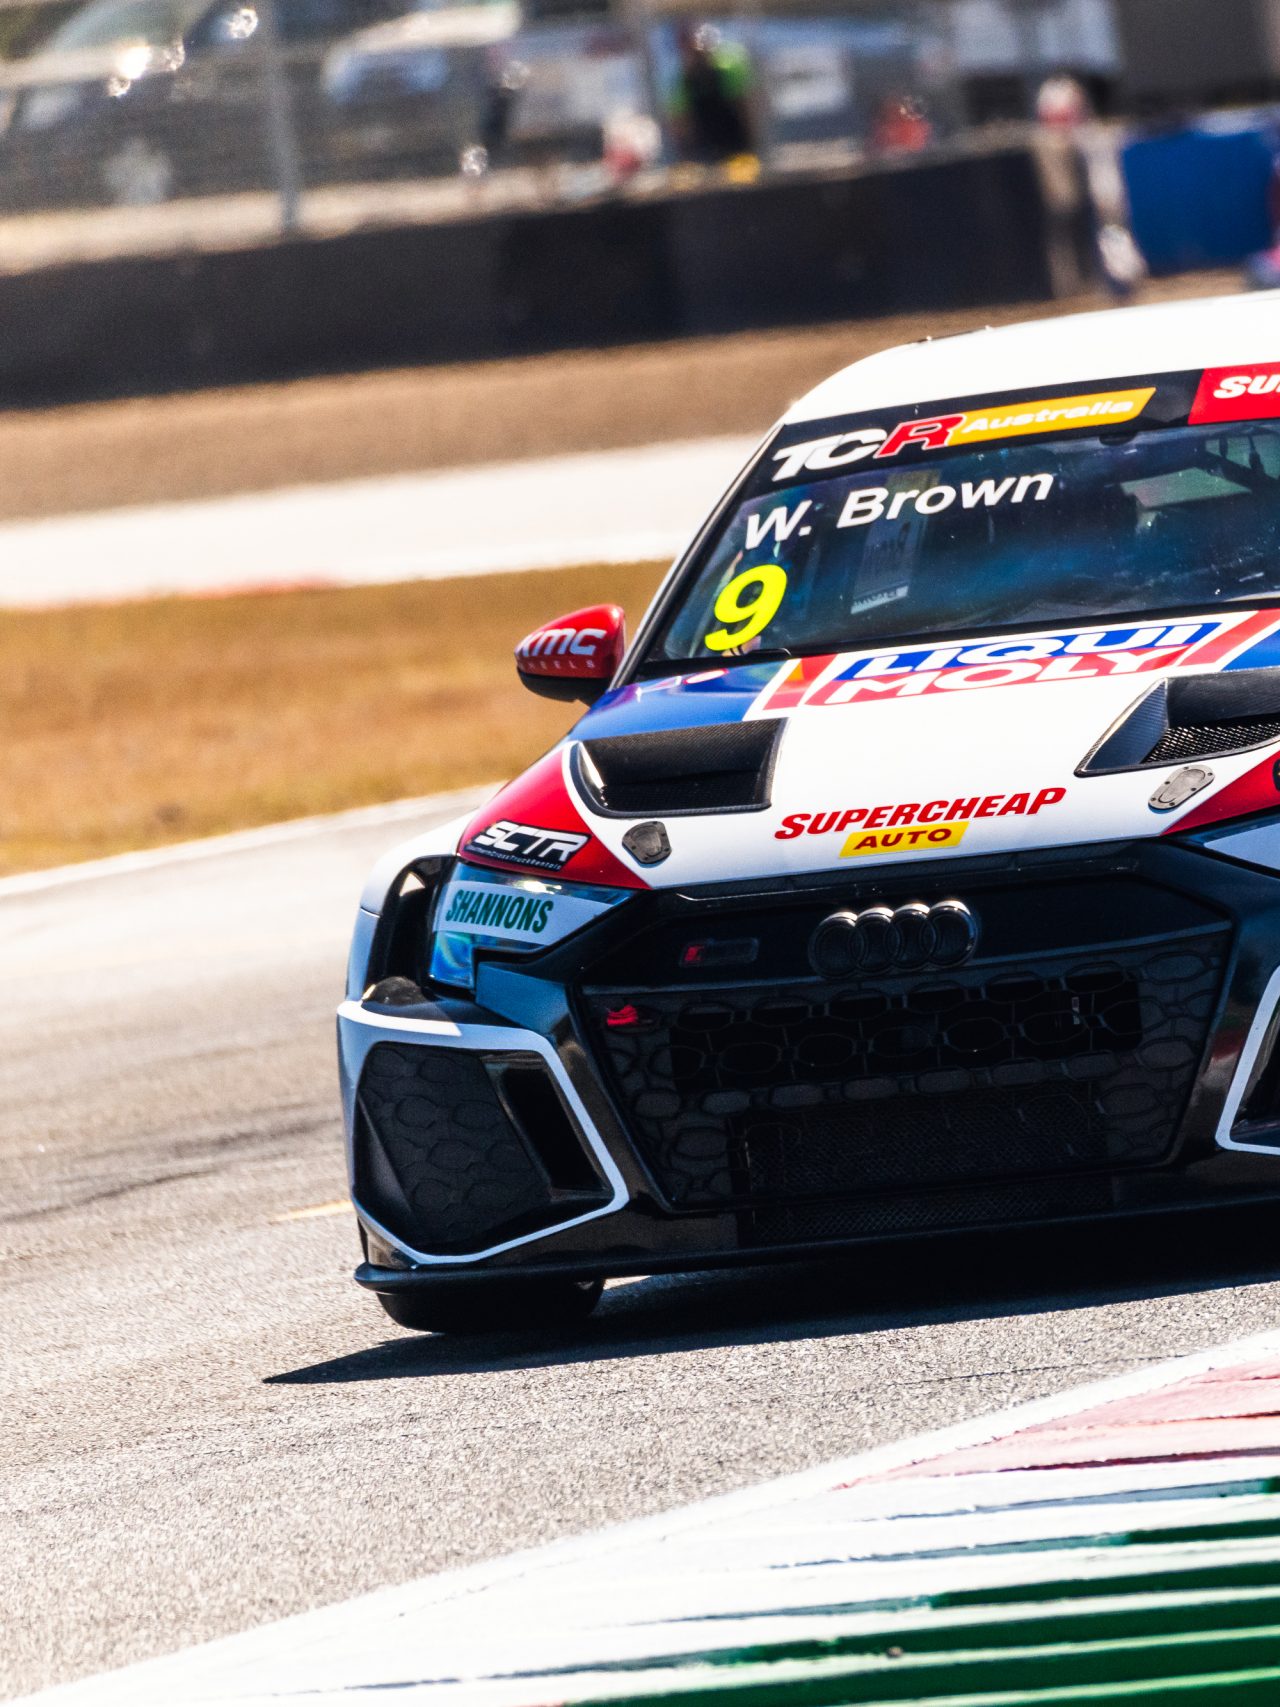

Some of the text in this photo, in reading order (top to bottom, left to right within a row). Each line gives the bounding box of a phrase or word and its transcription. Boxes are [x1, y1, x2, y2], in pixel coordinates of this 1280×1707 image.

[772, 400, 1133, 482] TCR Australia
[744, 472, 1054, 551] W. Brown
[704, 563, 788, 652] 9
[824, 645, 1184, 704] MOLY
[853, 624, 1217, 680] LIQUI
[474, 820, 589, 862] SCTR
[775, 787, 1066, 841] SUPERCHEAP
[854, 828, 952, 850] AUTO
[446, 889, 553, 933] SHANNONS
